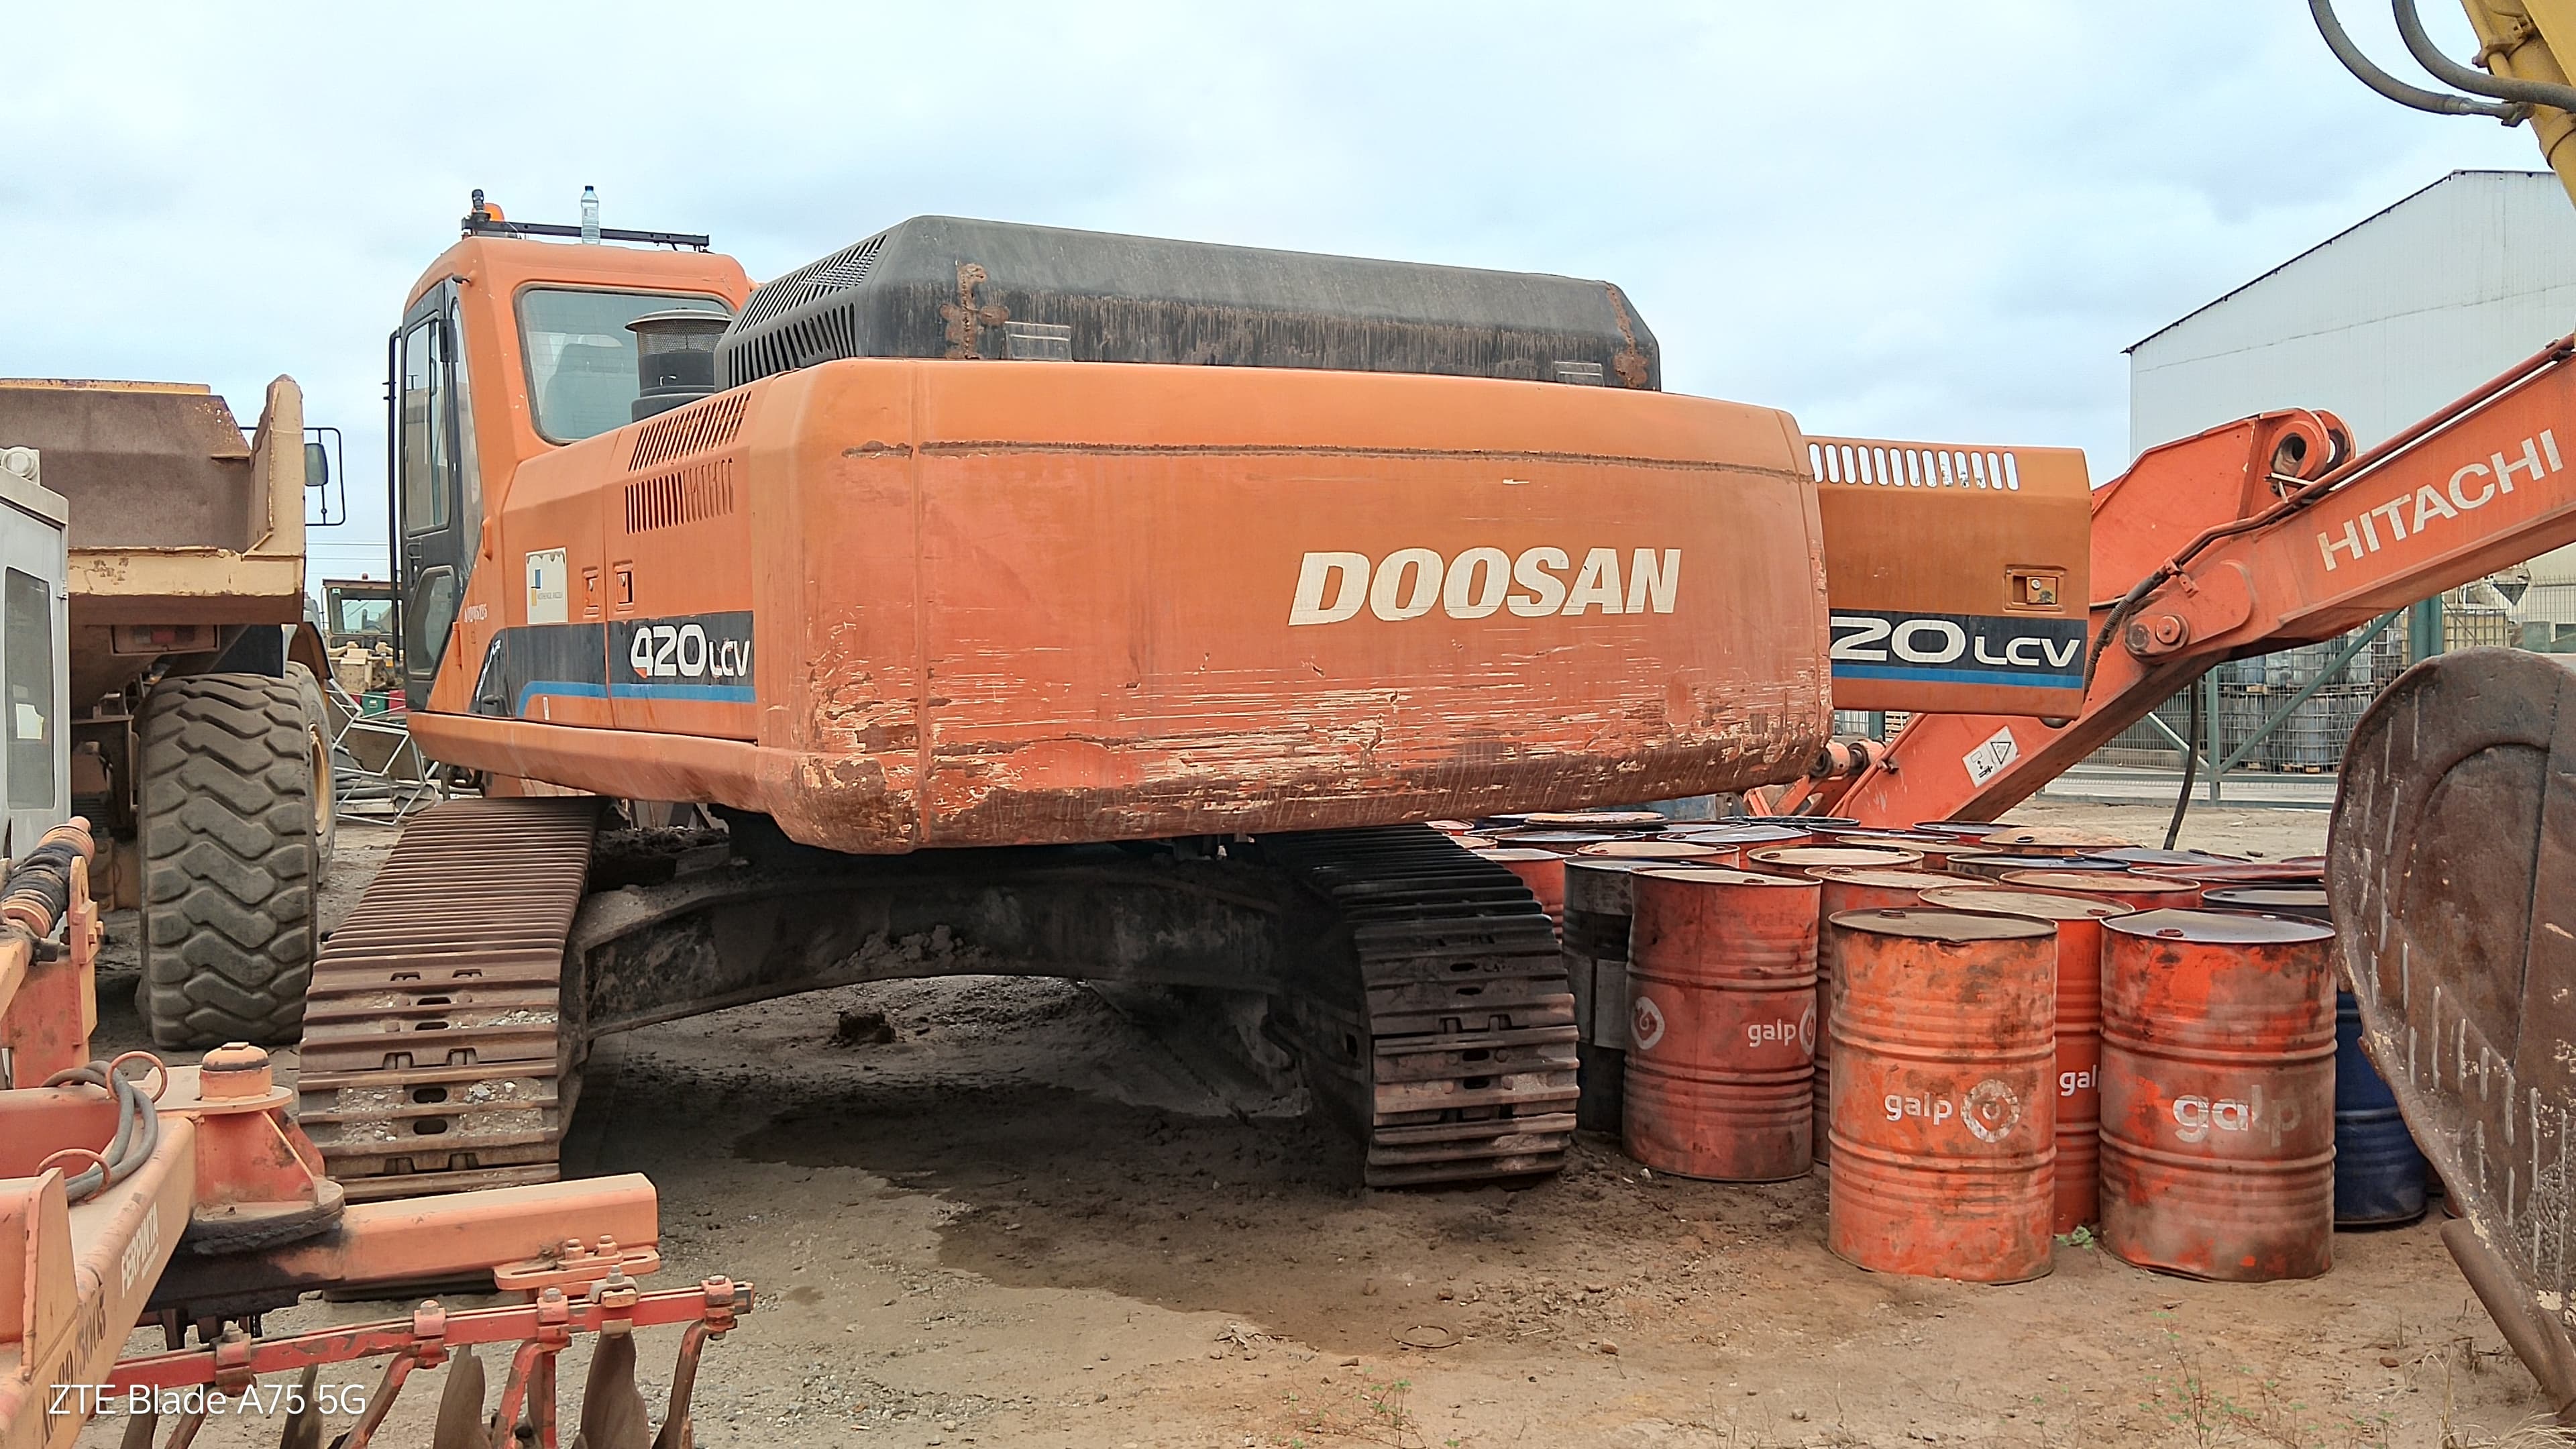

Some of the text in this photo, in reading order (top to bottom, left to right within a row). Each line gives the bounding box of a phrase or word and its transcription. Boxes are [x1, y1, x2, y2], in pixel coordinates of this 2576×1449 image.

[2317, 429, 2564, 572] HITACHI
[1289, 547, 1681, 626] DOOSAN
[631, 624, 706, 677] 420
[1830, 616, 2080, 667] 20 LCV
[1748, 1019, 1796, 1046] galp
[2059, 1065, 2101, 1097] gal
[1884, 1092, 1953, 1125] galp
[2173, 1084, 2302, 1147] galp
